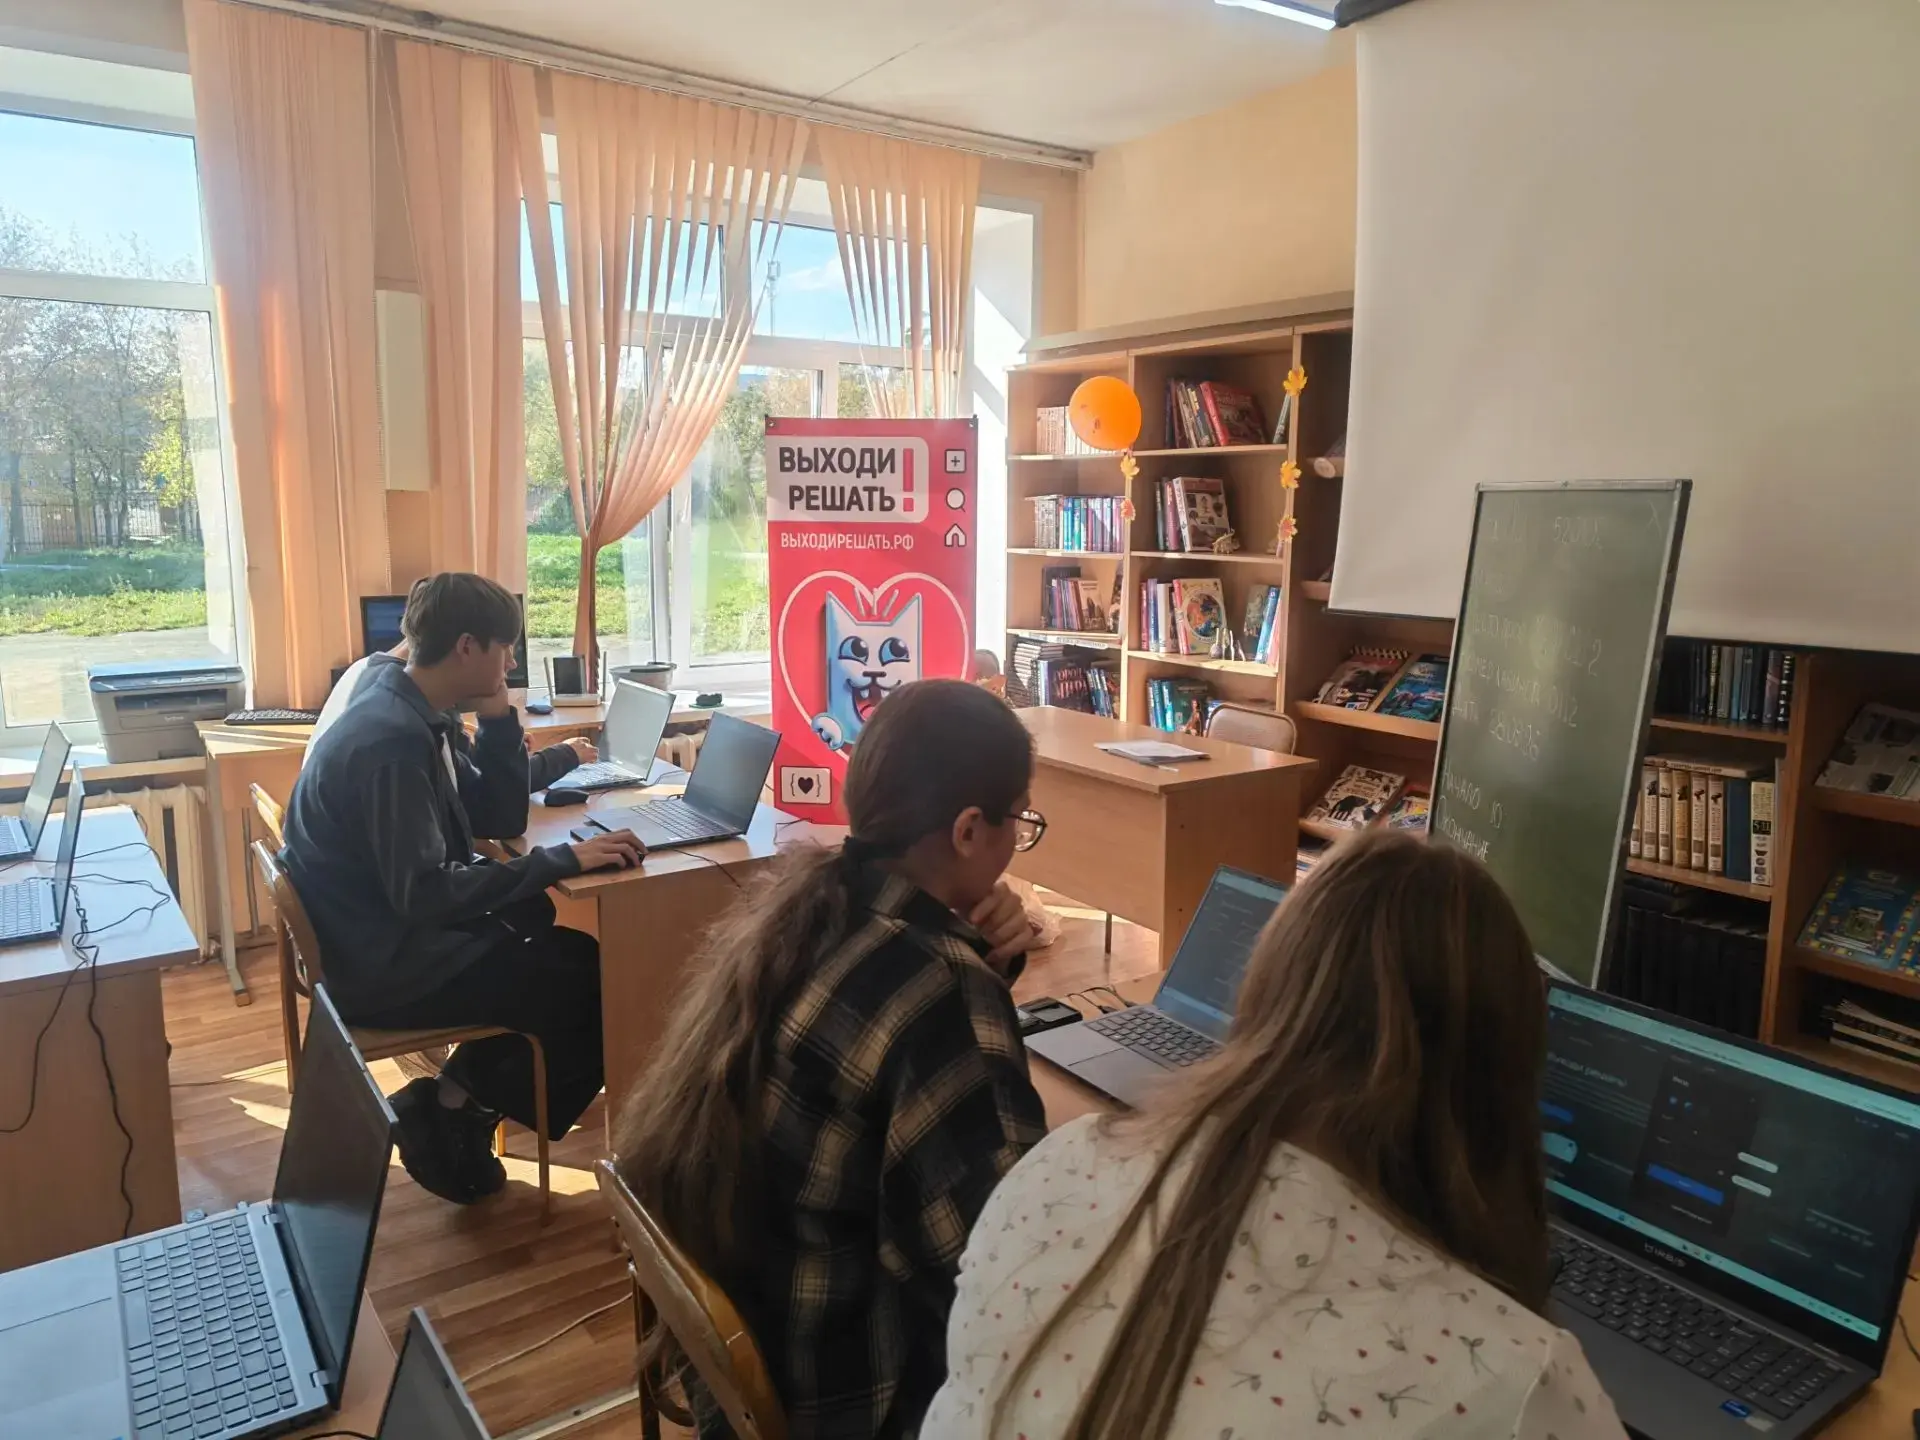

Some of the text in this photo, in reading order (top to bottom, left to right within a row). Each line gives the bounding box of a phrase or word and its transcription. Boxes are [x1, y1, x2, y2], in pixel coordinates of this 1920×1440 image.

[779, 447, 896, 478] ВЫХОДИ
[789, 485, 896, 512] РЕШАТЬ
[780, 532, 914, 551] ВЫХОДИРЕШАТЬ.РФ
